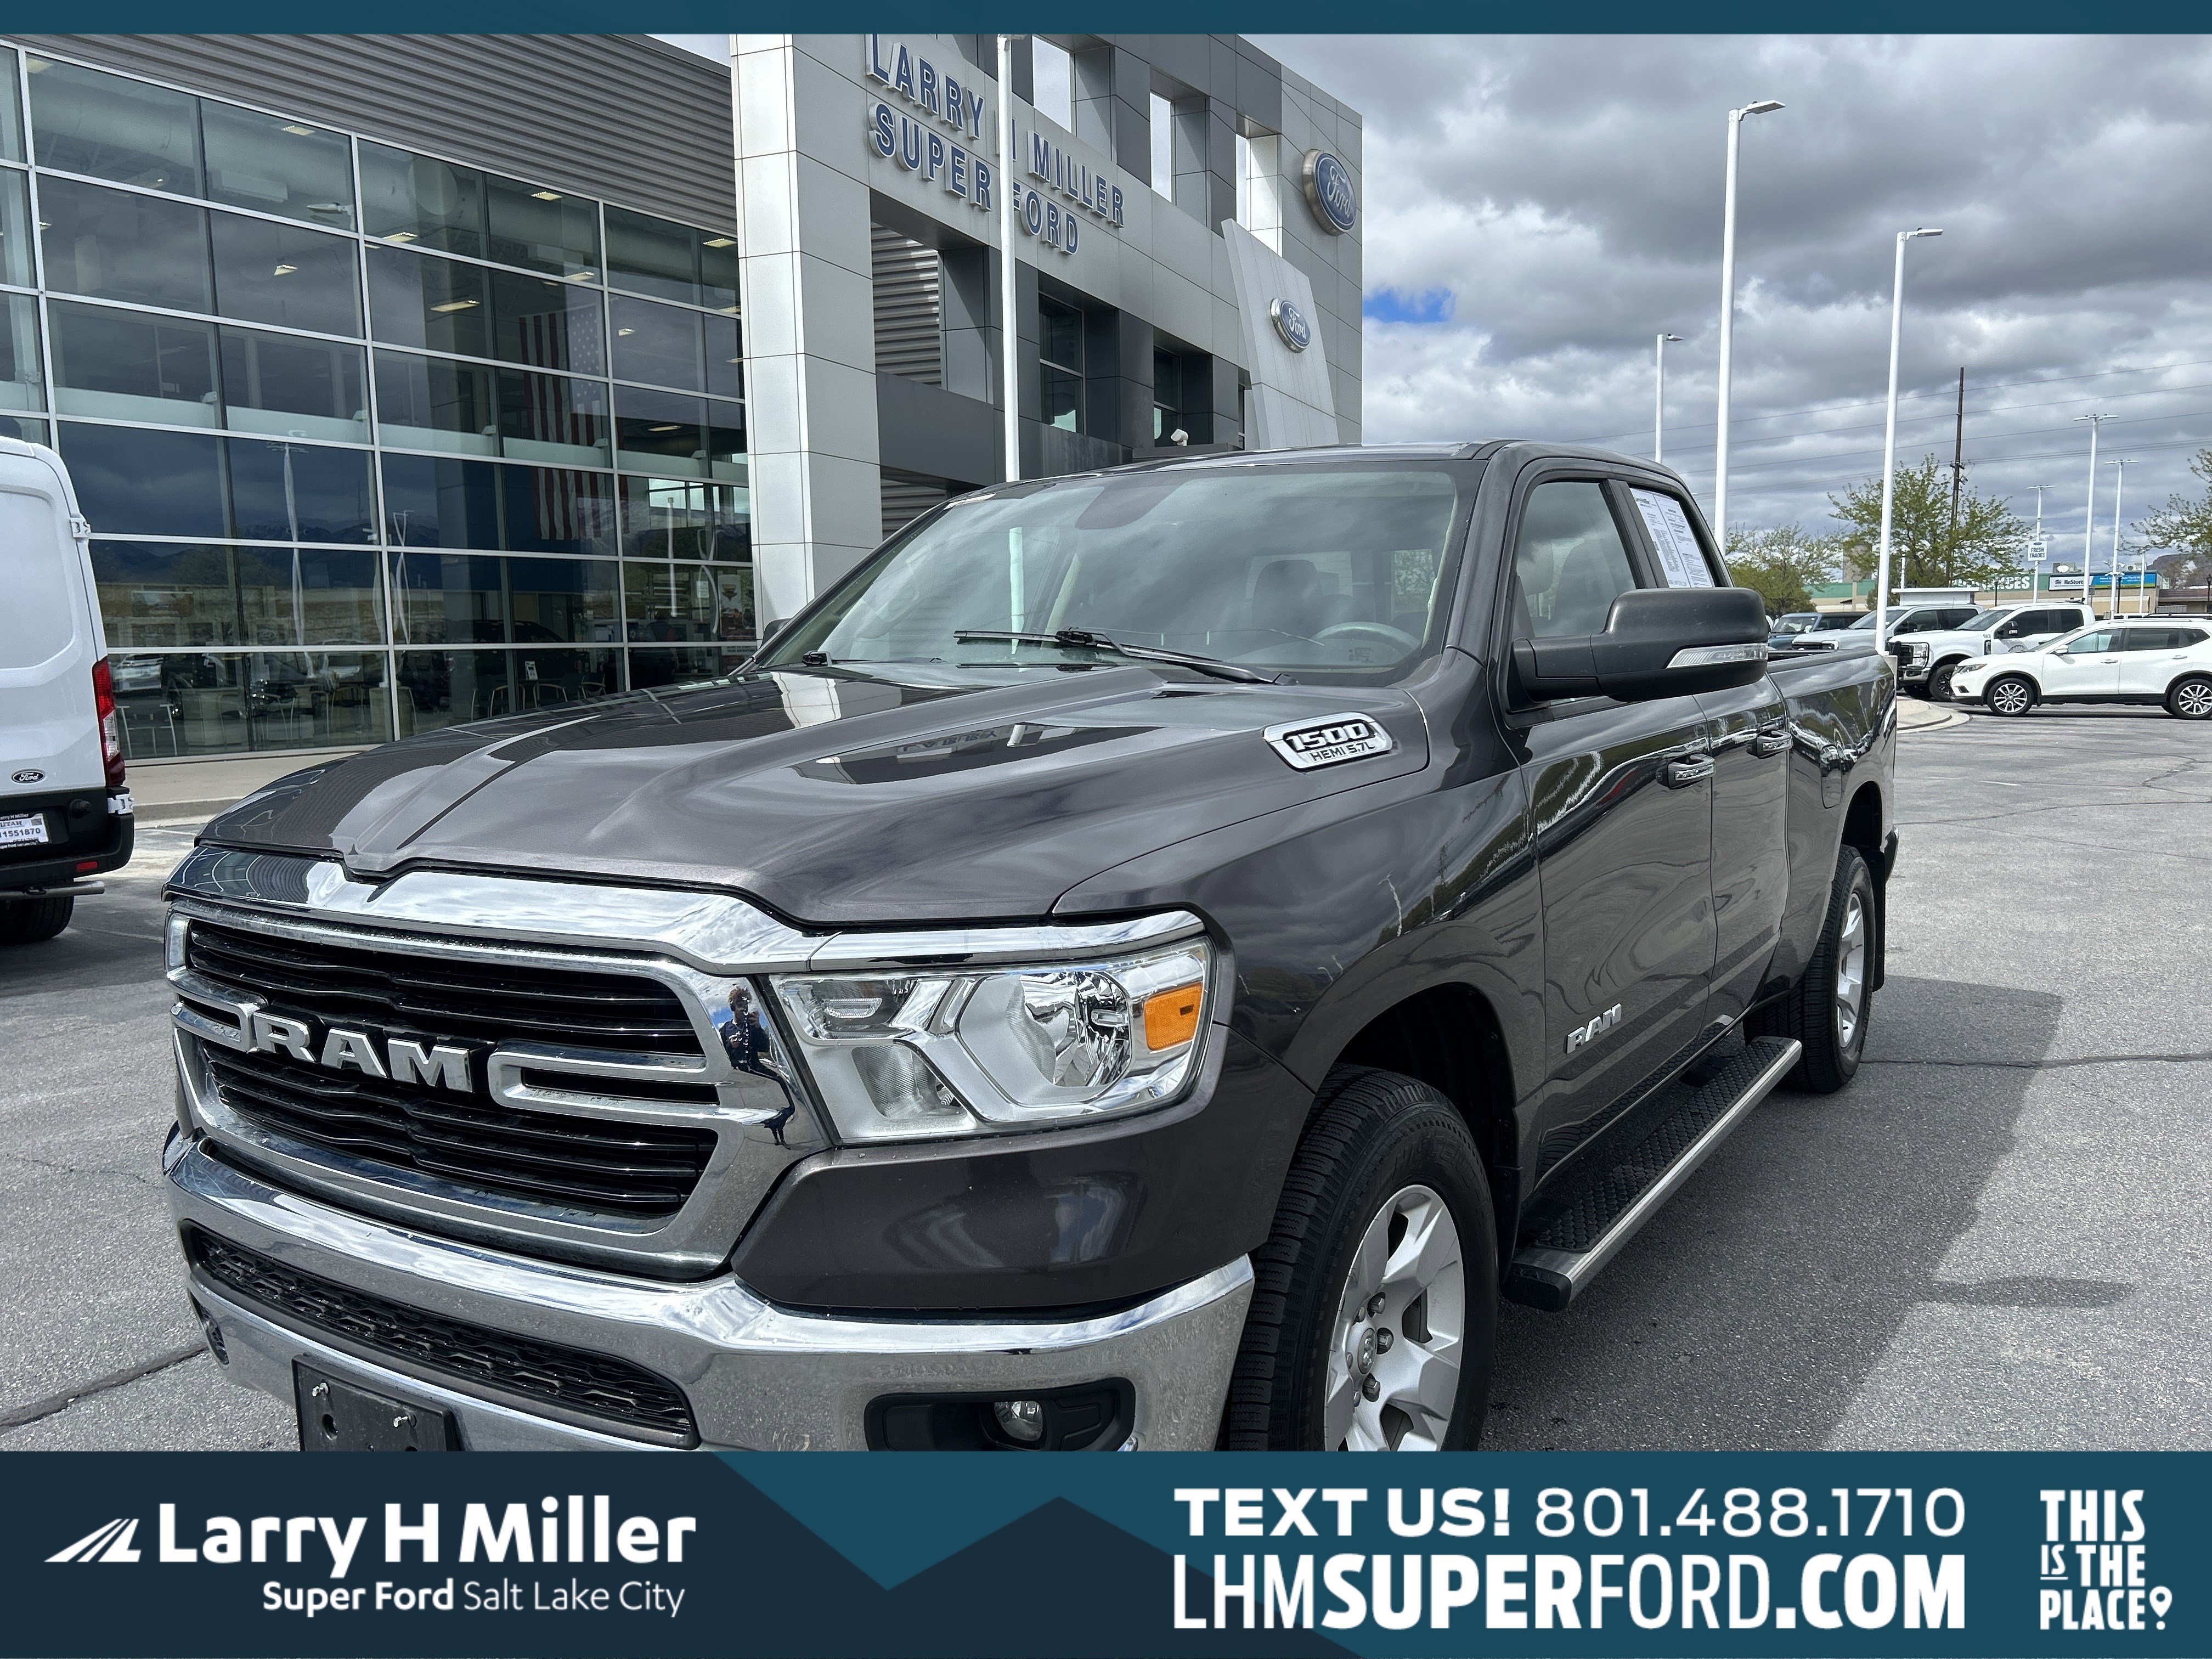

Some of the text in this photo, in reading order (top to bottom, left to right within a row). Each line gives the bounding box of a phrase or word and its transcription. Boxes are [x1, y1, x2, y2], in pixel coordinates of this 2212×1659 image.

[865, 34, 984, 140] LARRY
[1028, 129, 1124, 228] MILLER
[868, 102, 992, 212] SUPER
[1326, 165, 1351, 218] Ford
[1288, 307, 1307, 340] Ford
[1285, 722, 1369, 751] 1500
[1310, 742, 1376, 761] HEMI 5.7L
[19, 772, 39, 781] Ford
[253, 1011, 473, 1093] RAM
[1566, 1003, 1622, 1054] RAM
